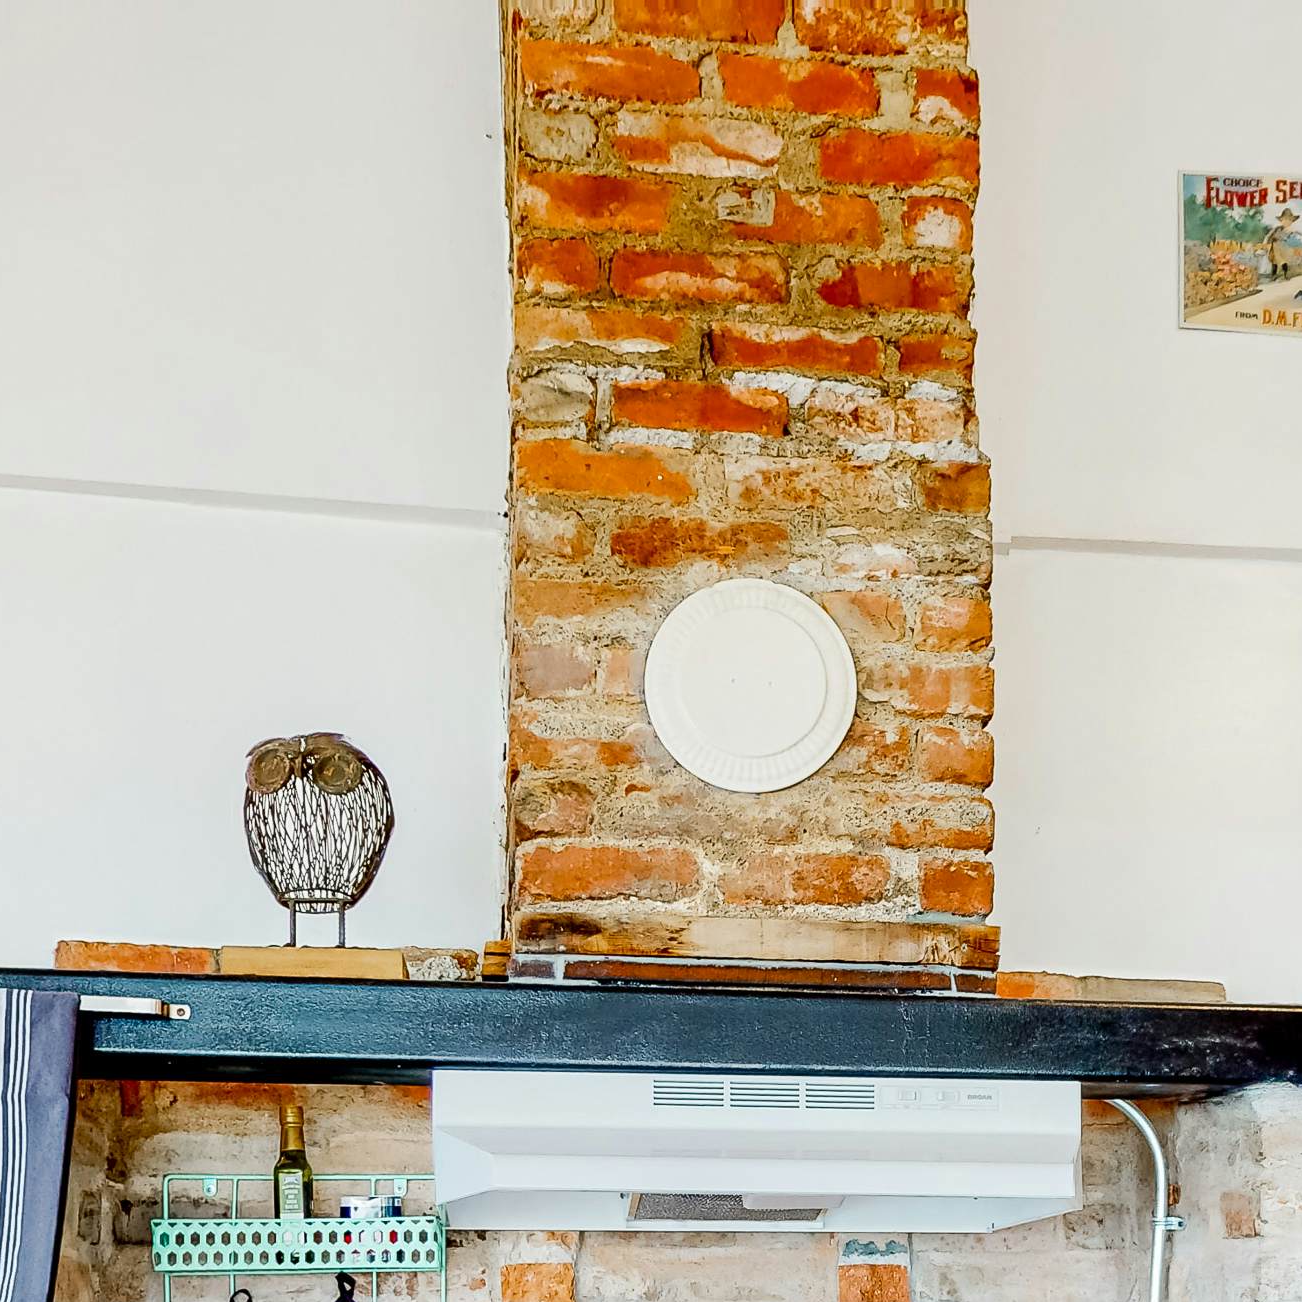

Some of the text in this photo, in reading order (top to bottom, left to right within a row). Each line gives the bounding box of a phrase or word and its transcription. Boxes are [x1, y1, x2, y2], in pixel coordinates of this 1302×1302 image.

[1223, 178, 1263, 187] CHOICE
[1205, 176, 1268, 208] FLOWER
[1235, 311, 1258, 320] FROM
